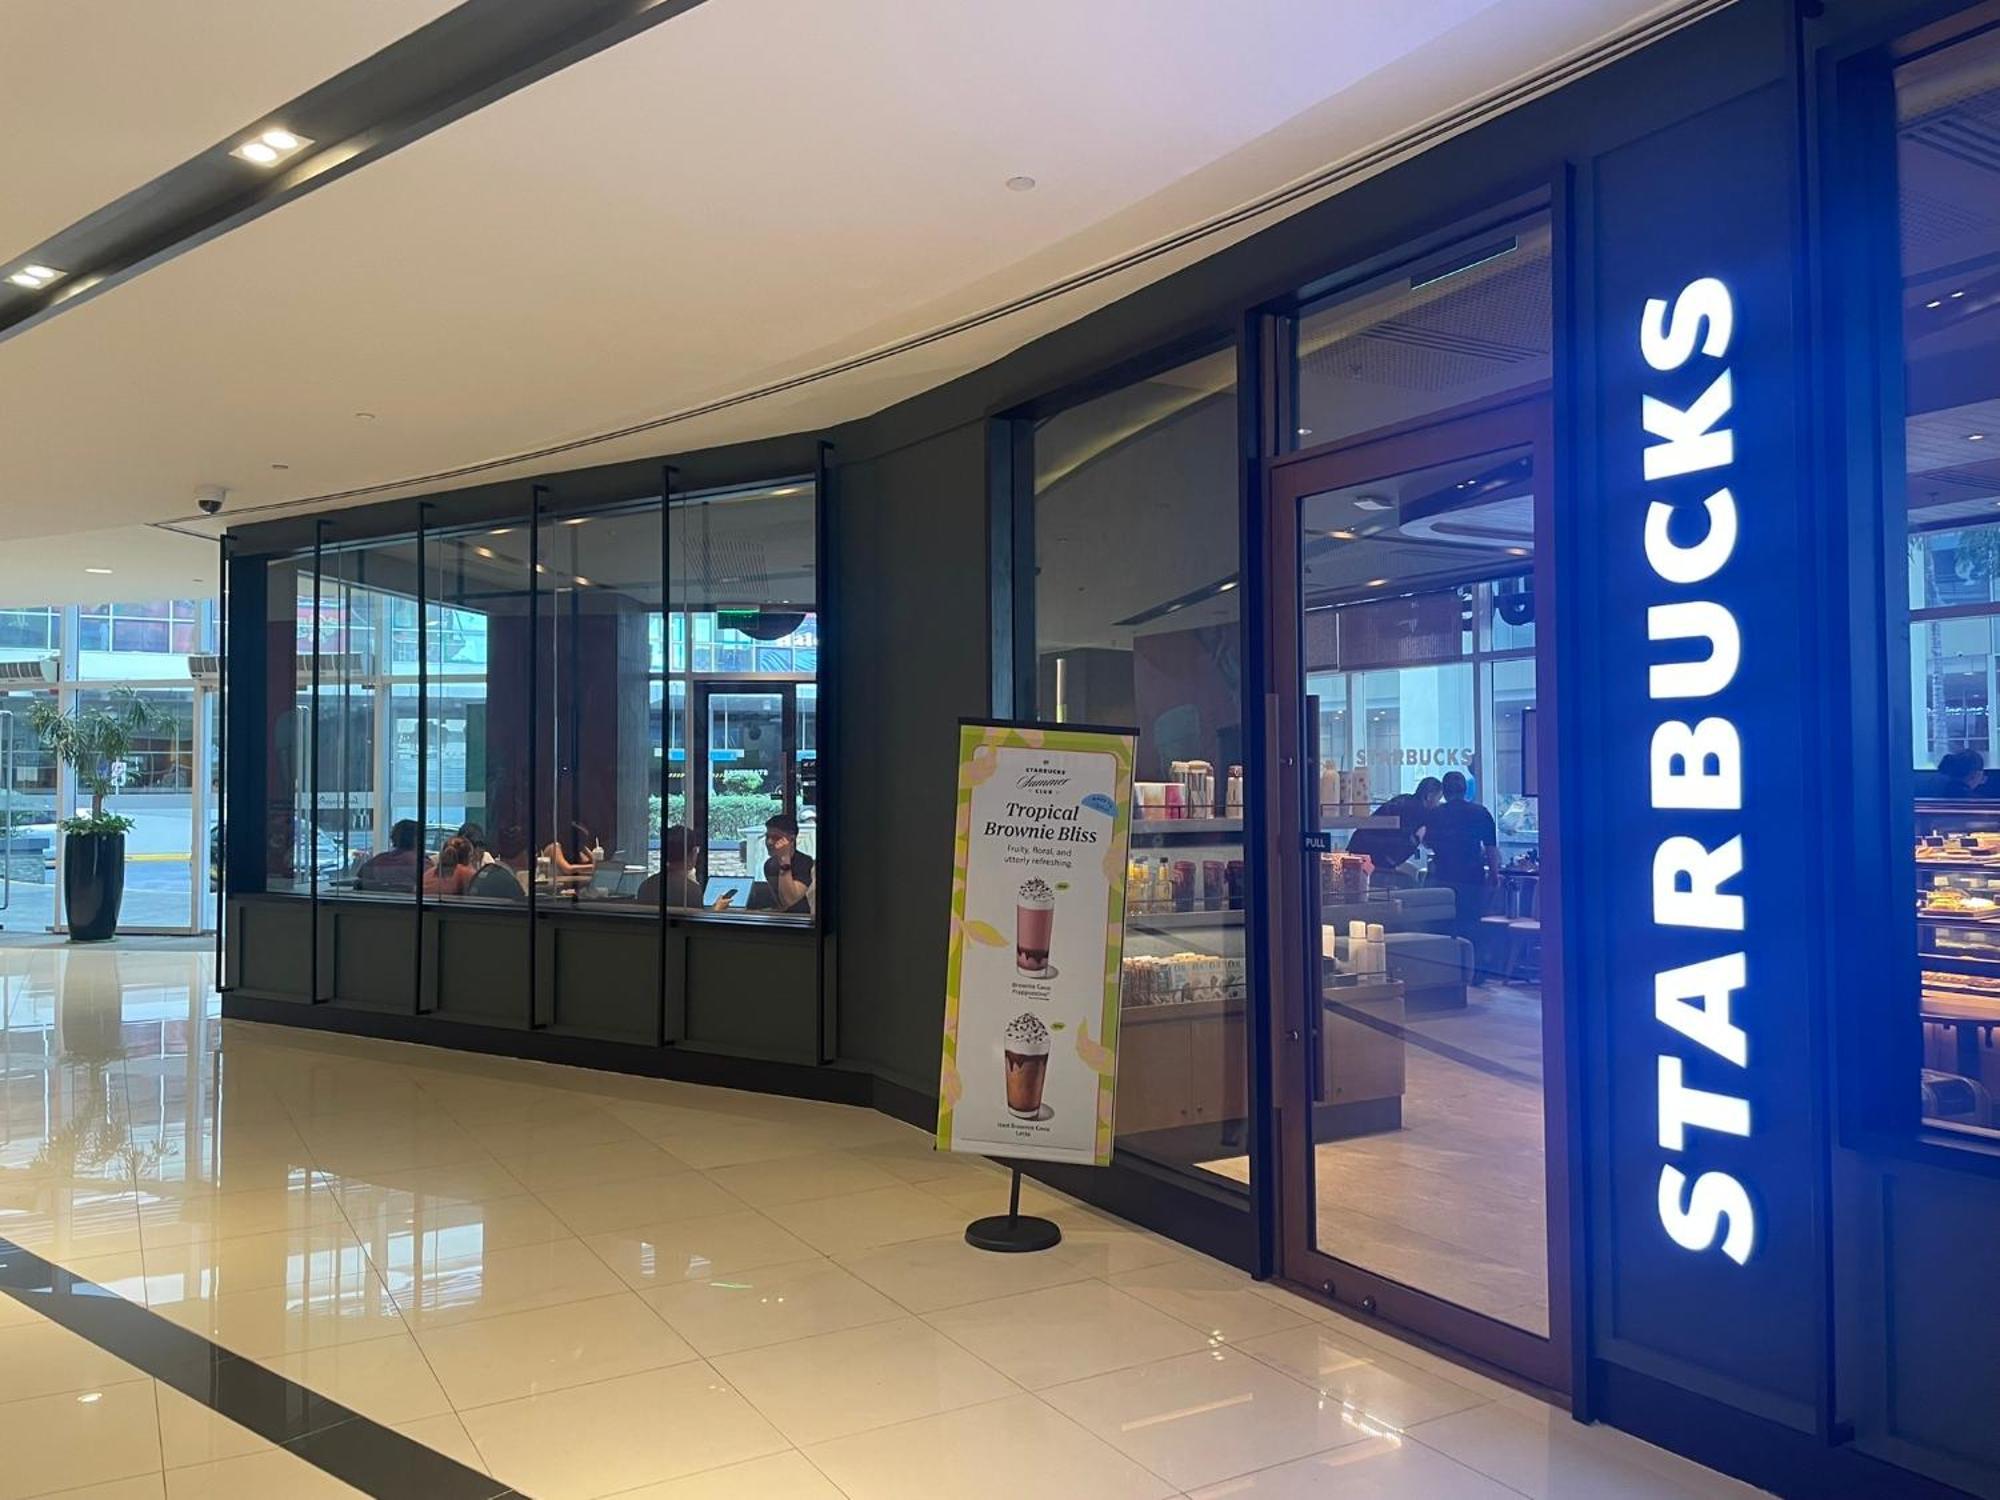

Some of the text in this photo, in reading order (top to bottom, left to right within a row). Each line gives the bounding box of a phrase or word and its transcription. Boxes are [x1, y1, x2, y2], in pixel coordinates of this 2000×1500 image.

[1641, 278, 1753, 1264] STARBUCKS
[1016, 775, 1071, 789] Summer
[1005, 802, 1079, 821] Tropical
[984, 821, 1097, 843] Brownie Bliss
[1305, 838, 1326, 848] PULL
[1007, 844, 1072, 857] Fruity, floral, and
[1004, 856, 1030, 866] utterly
